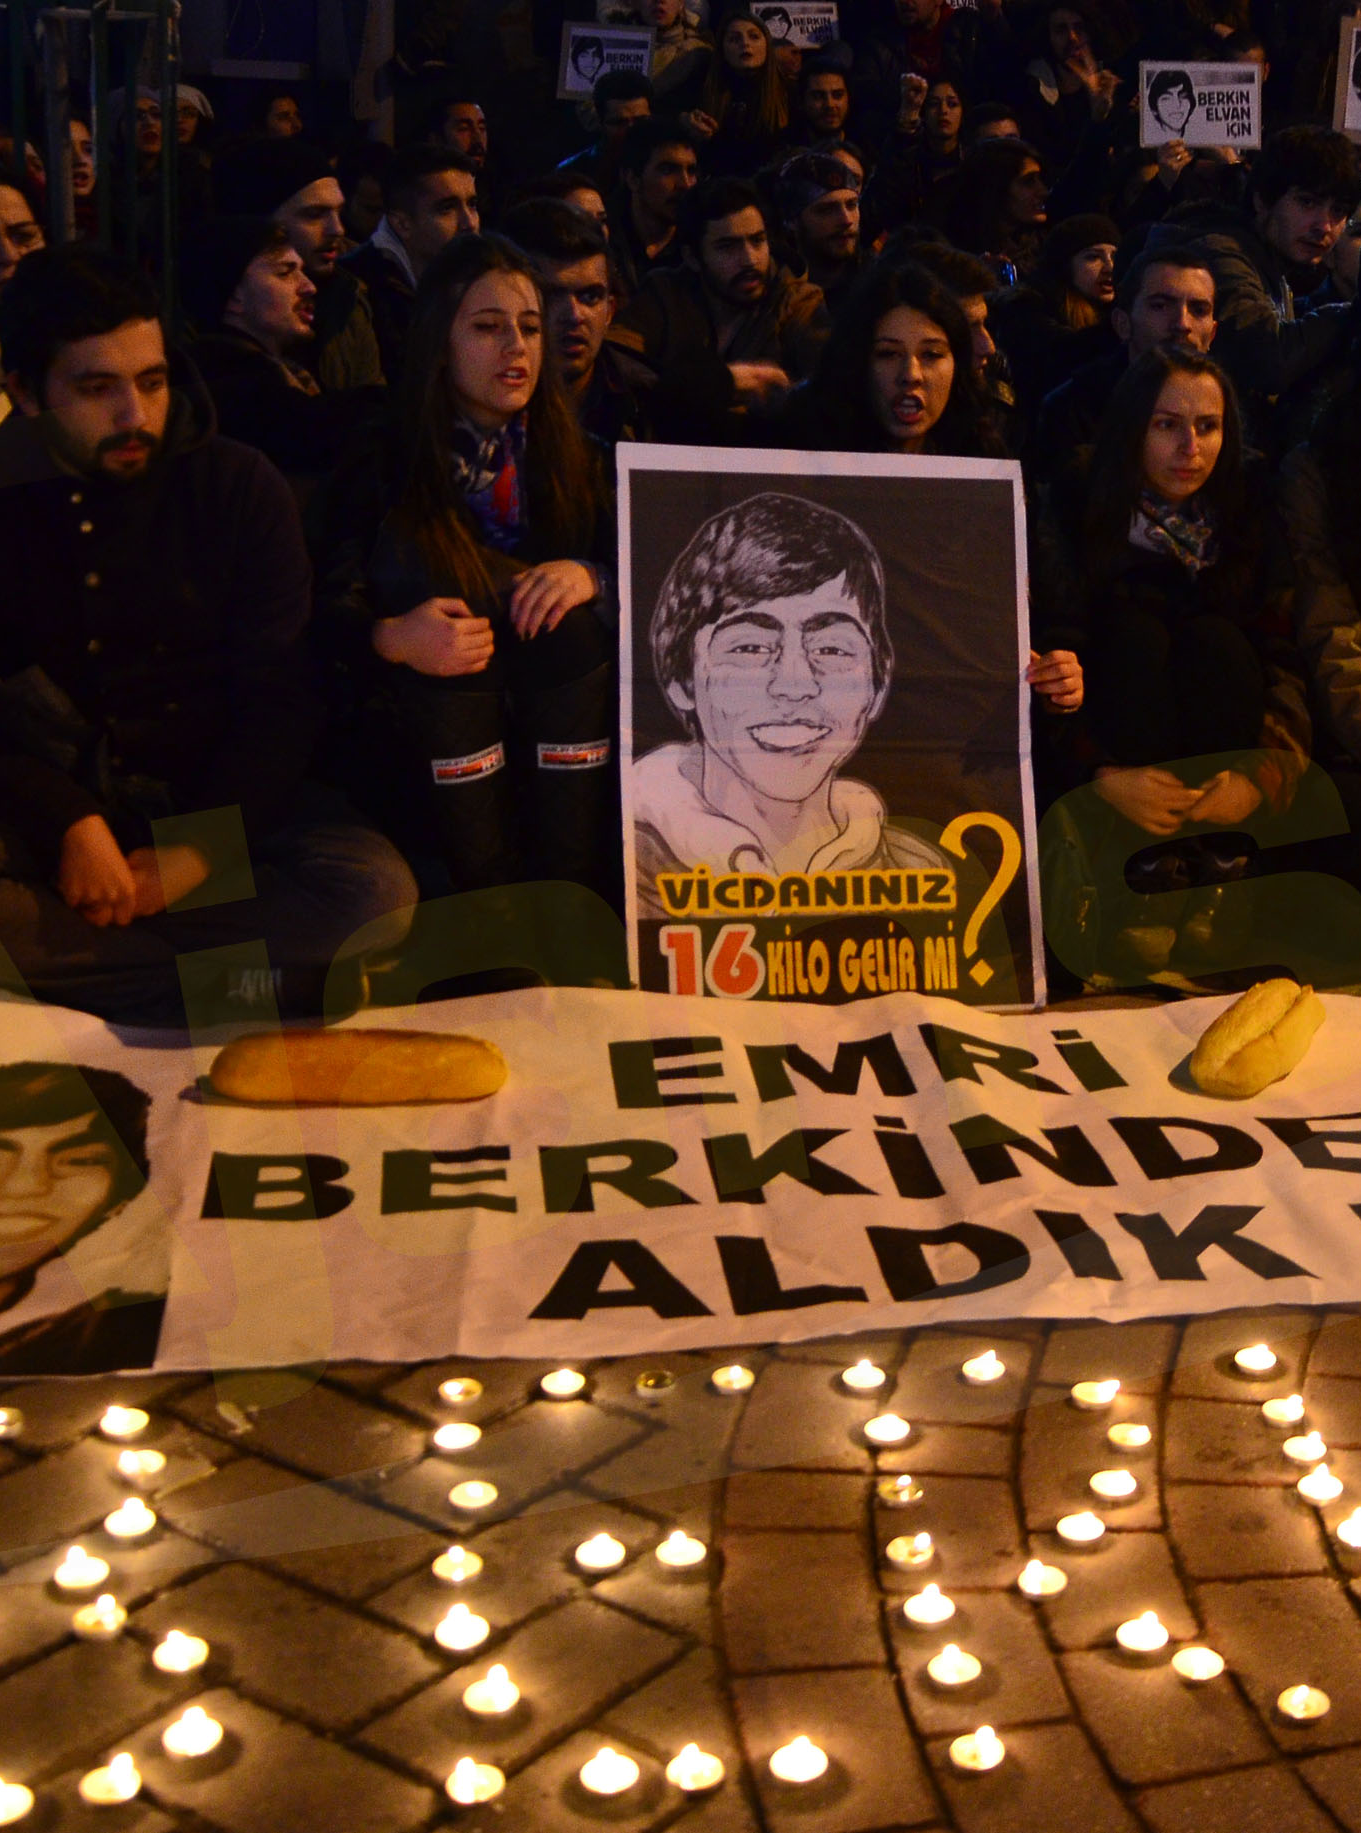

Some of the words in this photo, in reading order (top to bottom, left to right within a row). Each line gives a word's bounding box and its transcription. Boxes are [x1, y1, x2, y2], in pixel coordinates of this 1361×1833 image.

[1205, 106, 1251, 122] ELVAN
[659, 923, 767, 1000] 16
[939, 811, 1022, 986] ?
[528, 1204, 1322, 1322] ALDIK
